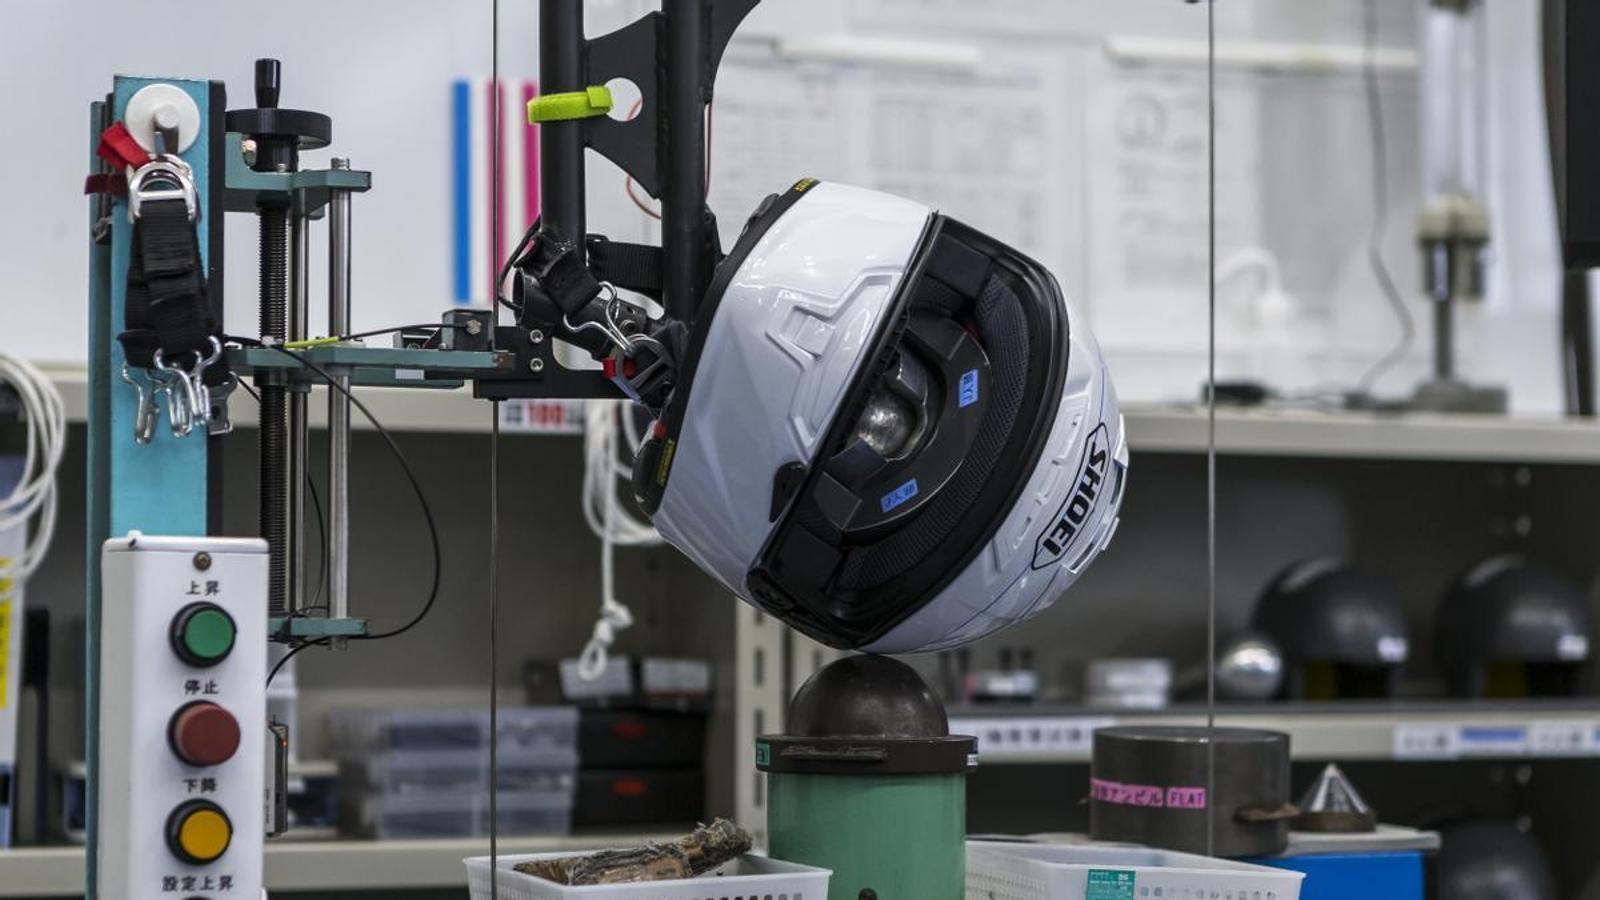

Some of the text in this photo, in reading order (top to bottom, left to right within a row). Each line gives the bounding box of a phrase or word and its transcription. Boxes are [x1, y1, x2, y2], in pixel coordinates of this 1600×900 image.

[1042, 441, 1107, 556] SHOEI
[184, 580, 220, 596] 上昇
[184, 679, 219, 695] 停止
[183, 778, 217, 793] 下降
[1170, 792, 1204, 805] FLAT
[162, 875, 233, 892] 設定上昇
